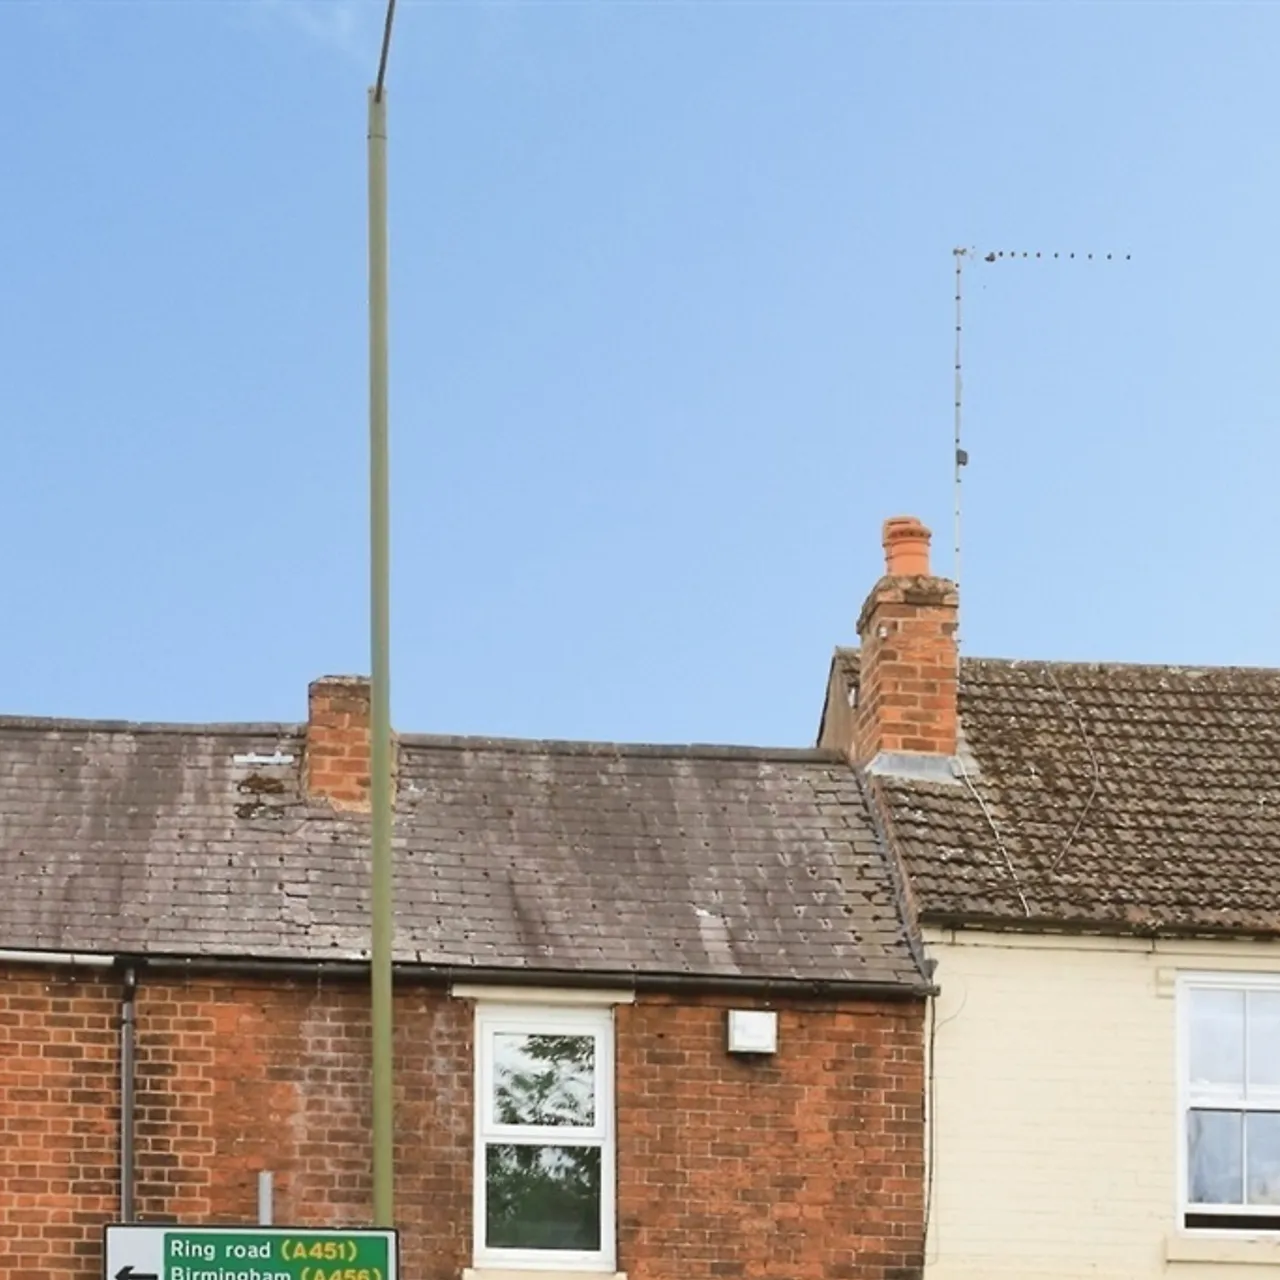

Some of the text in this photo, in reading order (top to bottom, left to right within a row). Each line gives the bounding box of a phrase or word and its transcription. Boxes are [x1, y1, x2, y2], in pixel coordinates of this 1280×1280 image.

[171, 1239, 357, 1261] Ring road (A451)
